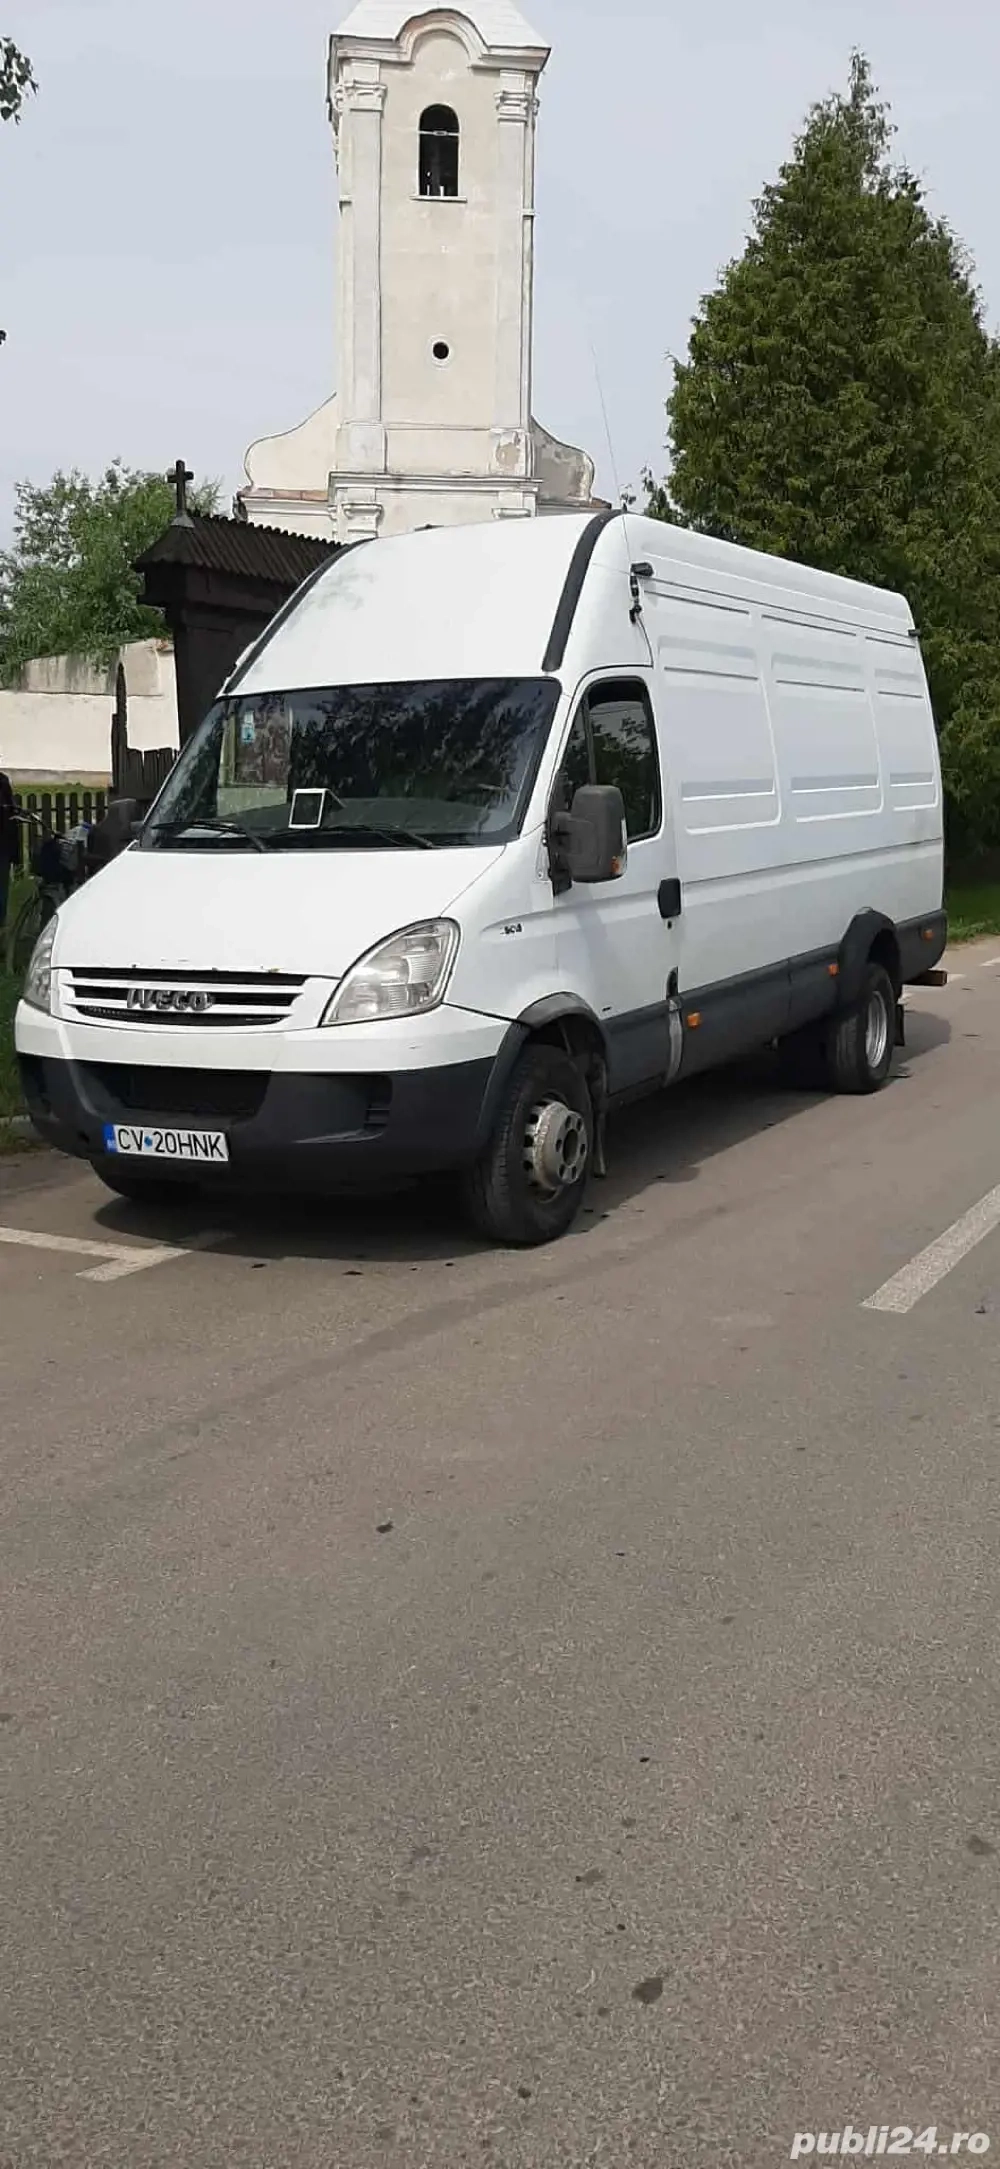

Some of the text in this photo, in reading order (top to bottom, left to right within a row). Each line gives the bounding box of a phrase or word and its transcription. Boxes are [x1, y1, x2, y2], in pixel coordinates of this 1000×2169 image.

[126, 988, 212, 1011] IVECO
[118, 1128, 144, 1151] CV
[153, 1131, 225, 1158] 20HNK
